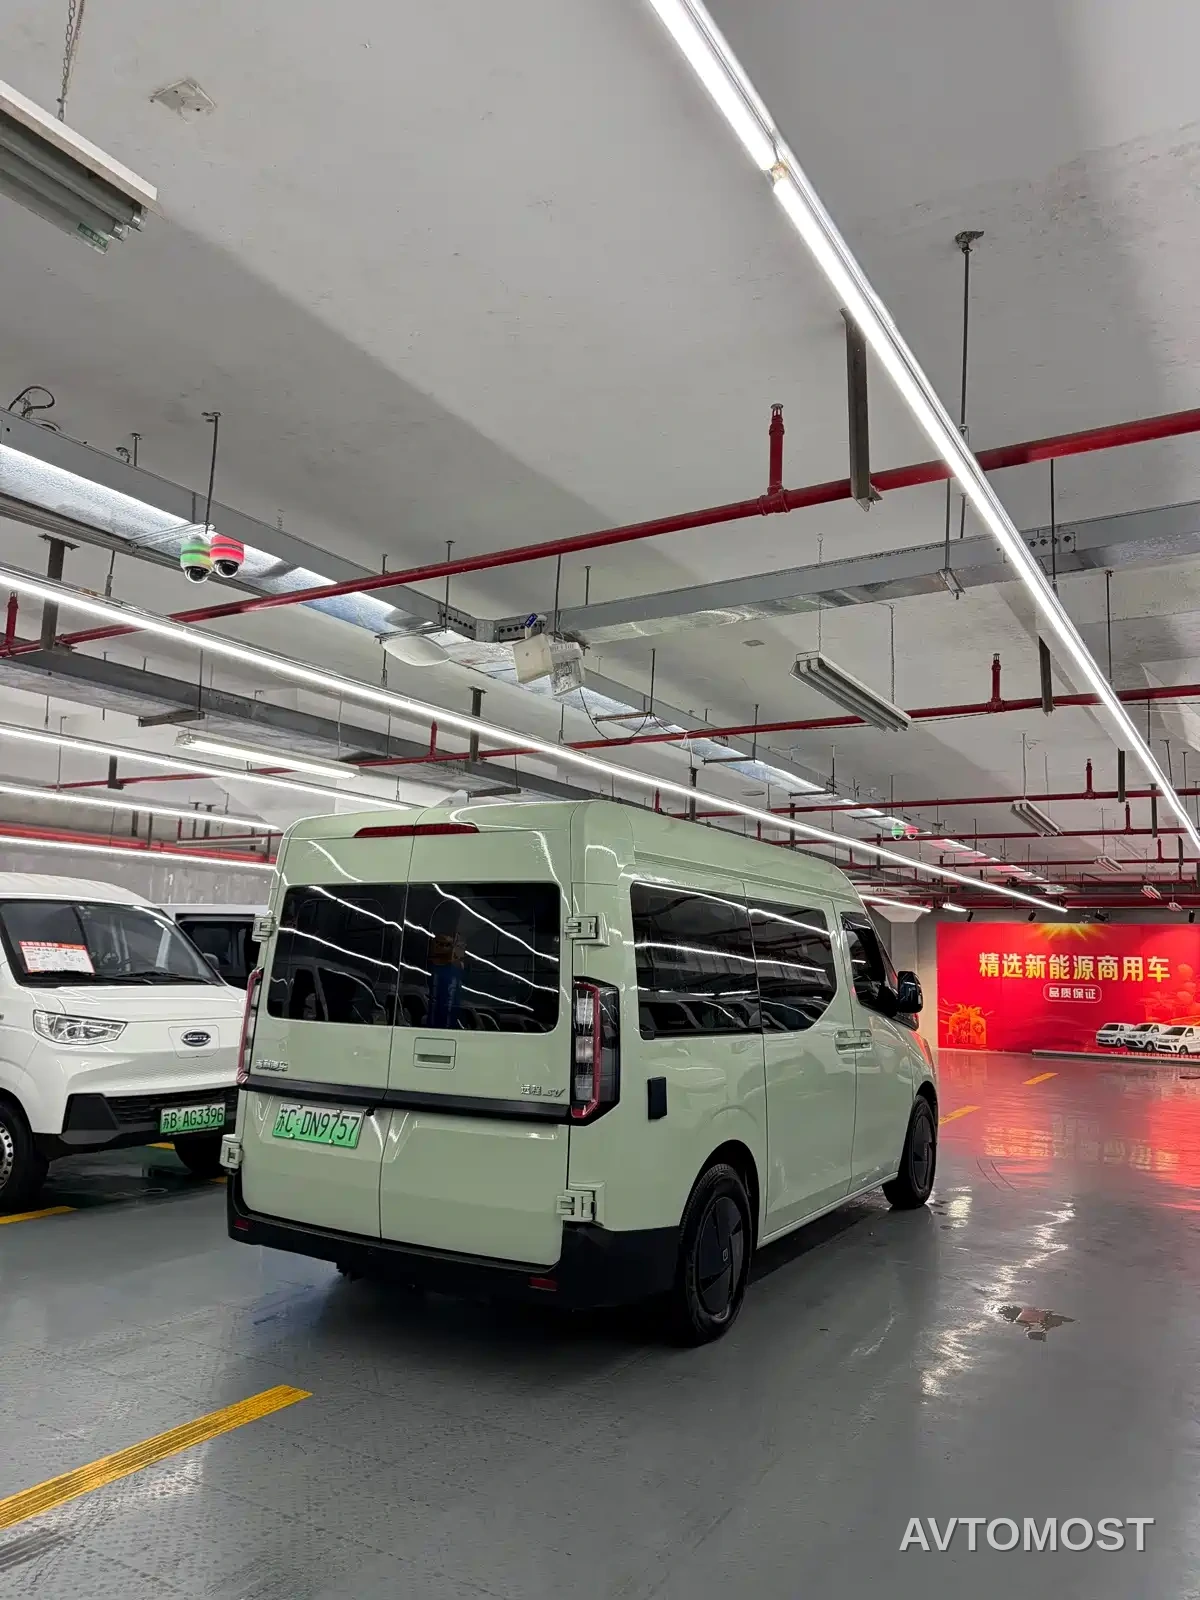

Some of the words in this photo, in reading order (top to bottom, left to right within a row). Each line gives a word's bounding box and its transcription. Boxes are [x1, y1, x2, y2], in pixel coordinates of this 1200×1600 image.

[979, 952, 1171, 983] 精选新能源商用车
[1048, 987, 1097, 1000] 品质保证
